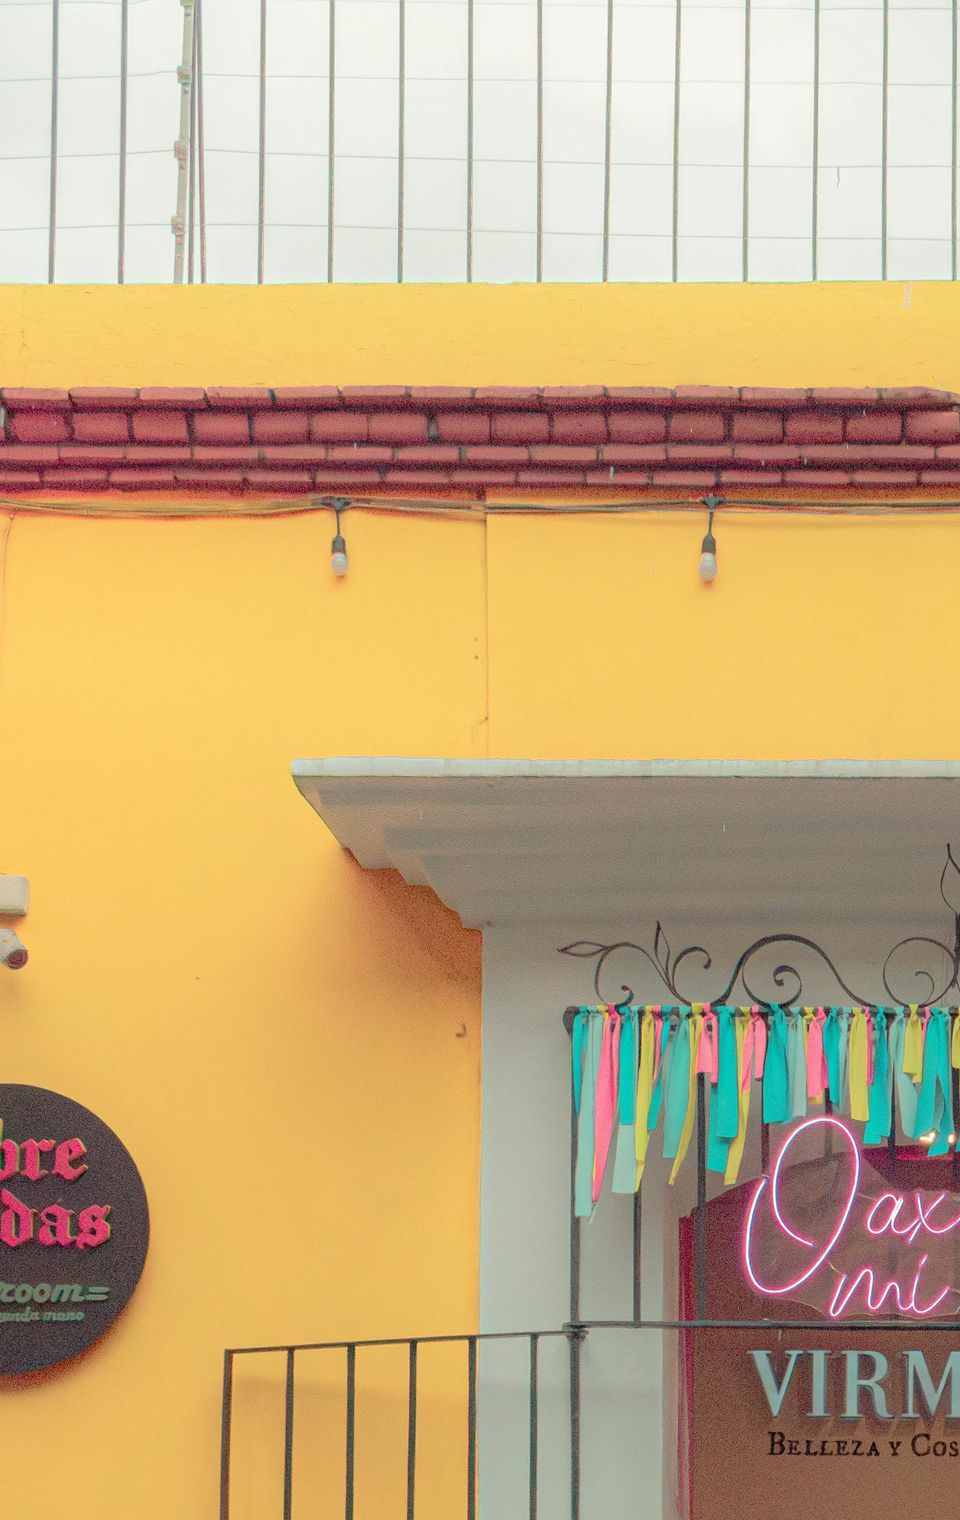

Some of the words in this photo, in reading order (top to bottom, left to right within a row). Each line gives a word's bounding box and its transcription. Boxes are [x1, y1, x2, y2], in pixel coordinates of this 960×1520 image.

[0, 1187, 112, 1249] das
[828, 1253, 951, 1318] mi
[767, 1431, 881, 1457] BELLEZA
